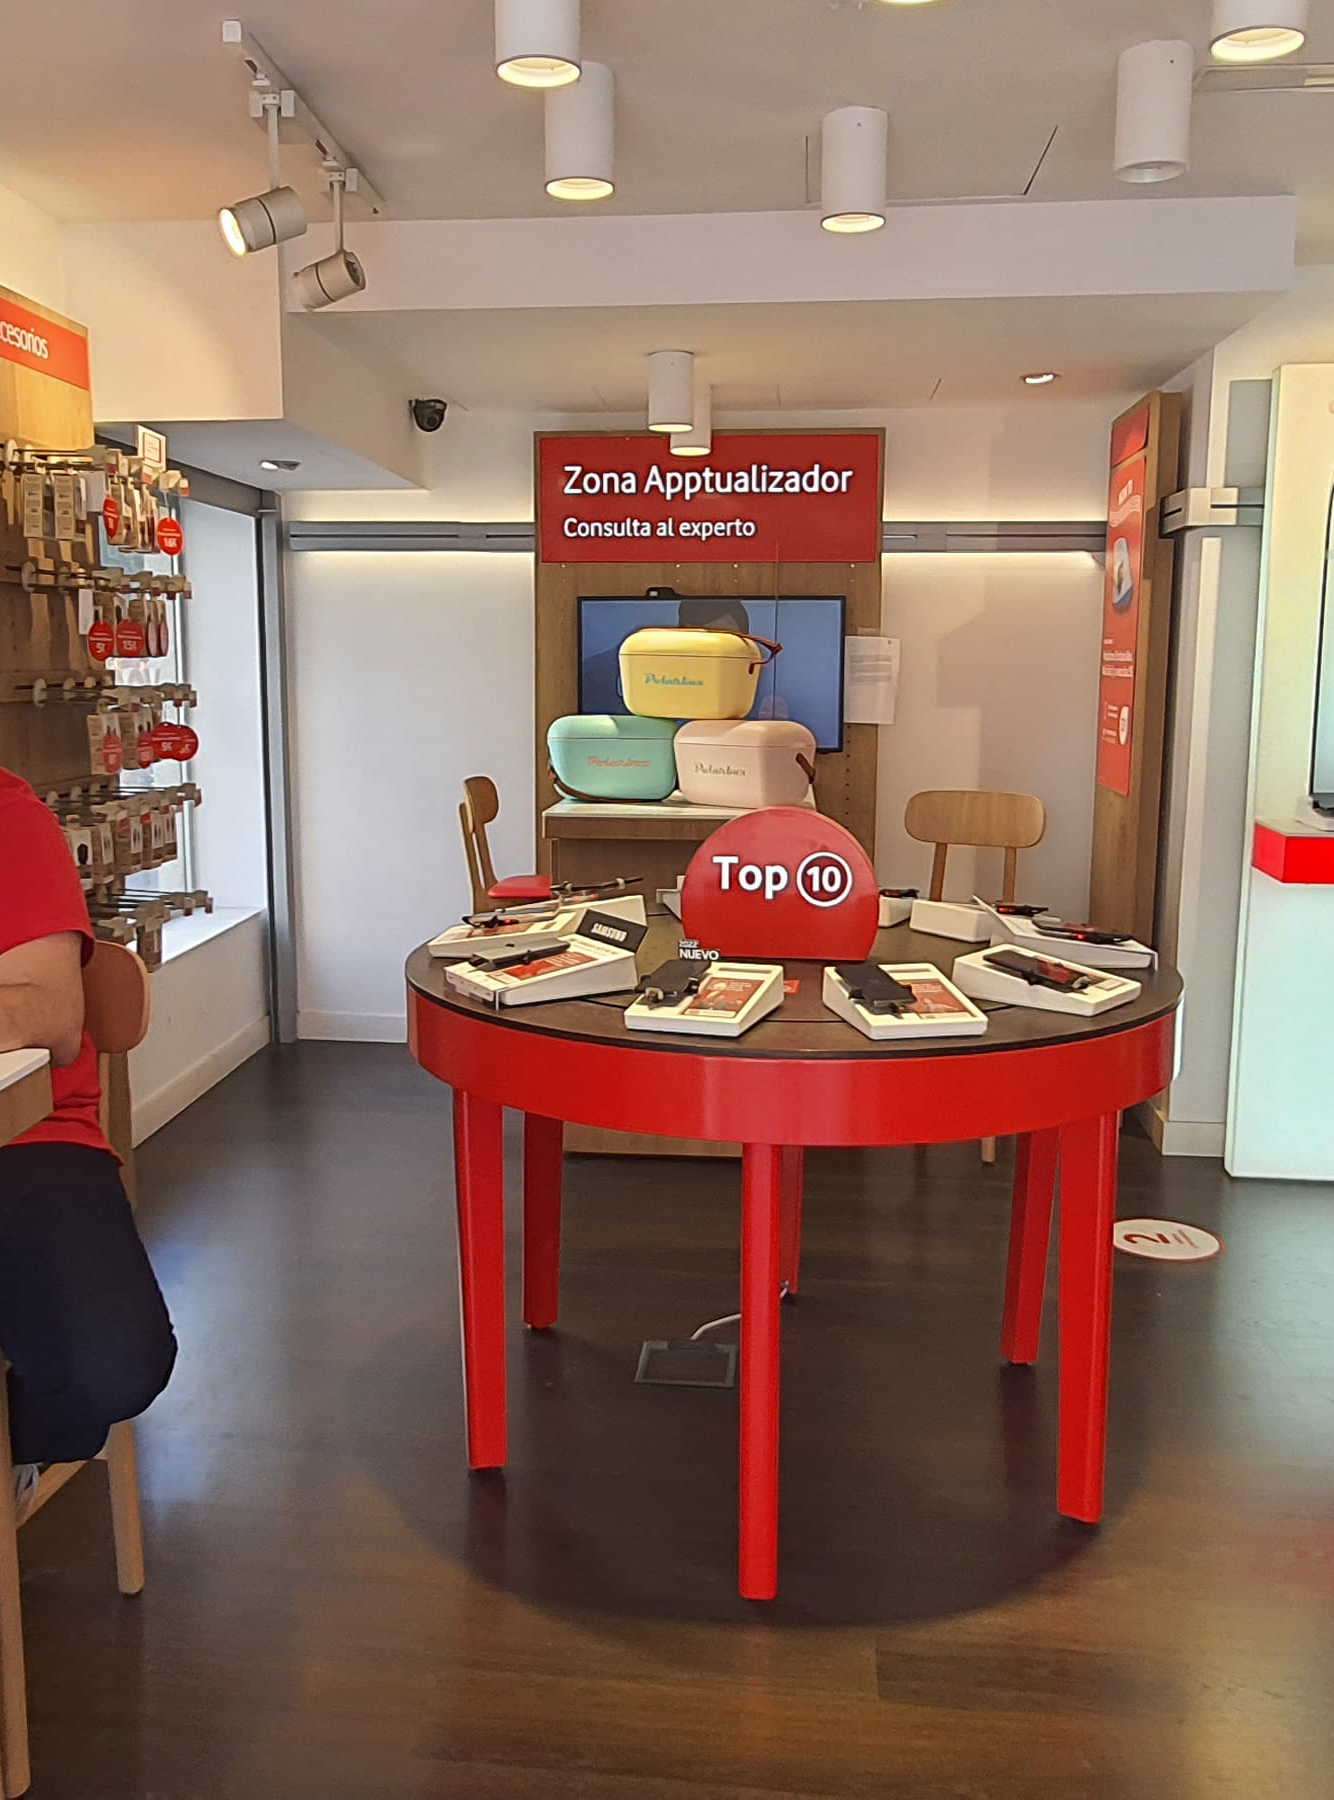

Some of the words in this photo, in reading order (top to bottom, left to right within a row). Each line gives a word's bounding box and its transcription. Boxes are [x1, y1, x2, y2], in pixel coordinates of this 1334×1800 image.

[563, 465, 637, 494] Zona
[644, 464, 854, 500] Apptualizador
[563, 517, 652, 537] Consulta
[656, 517, 675, 537] al
[679, 519, 756, 541] experto
[712, 855, 789, 900] Top
[590, 922, 628, 942] SAMSUNG
[679, 949, 720, 961] NUEVO
